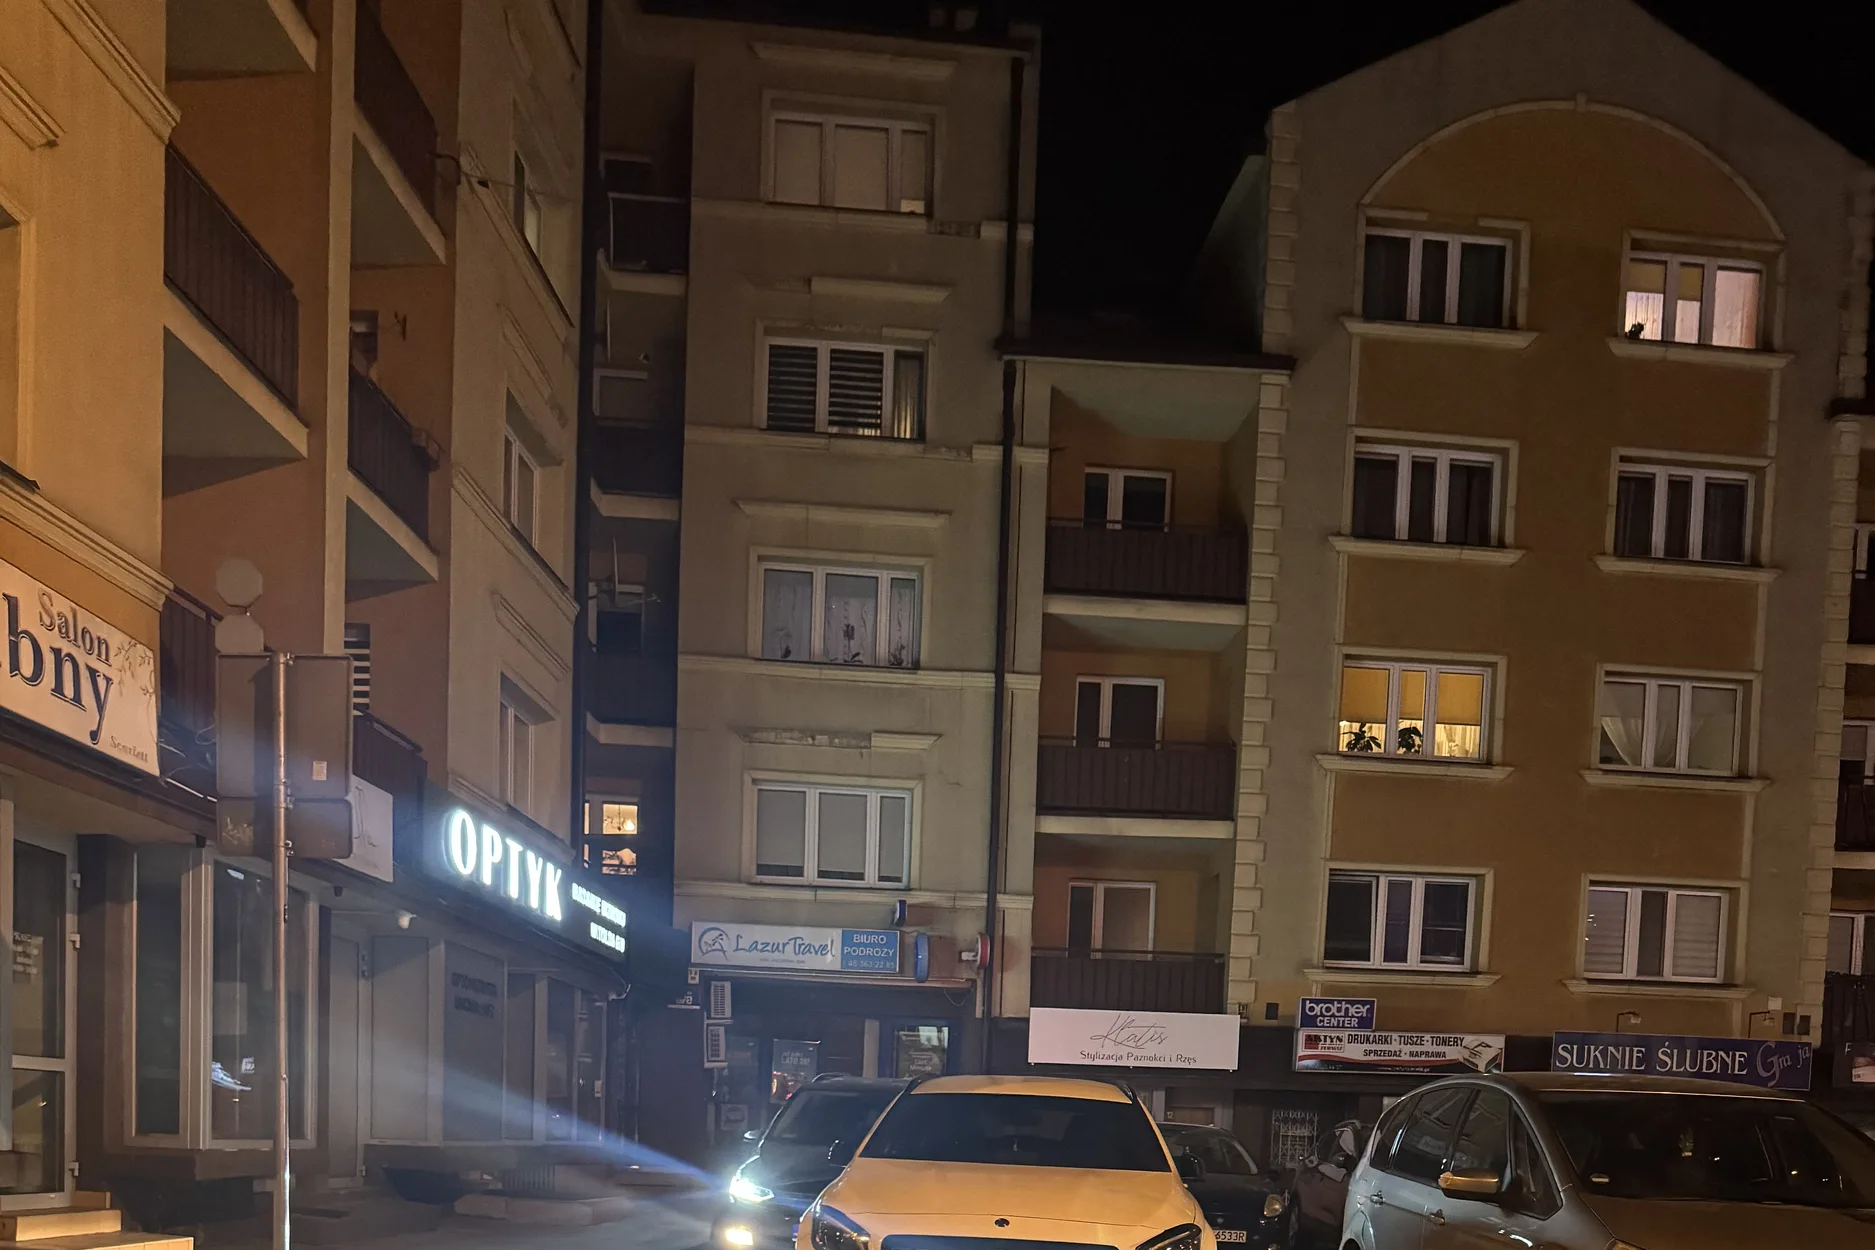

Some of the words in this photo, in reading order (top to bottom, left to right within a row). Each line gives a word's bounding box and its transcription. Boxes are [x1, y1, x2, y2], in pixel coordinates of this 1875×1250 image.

[38, 587, 112, 667] Salon
[0, 591, 114, 745] bny
[450, 809, 563, 922] OPTYK
[853, 934, 887, 944] BIURO
[1305, 1000, 1370, 1018] brother
[1316, 1016, 1359, 1027] CENTER
[1347, 1033, 1393, 1045] DRUKARKI
[1398, 1034, 1425, 1046] TUSZE
[1430, 1035, 1466, 1048] TONERY
[1079, 1050, 1123, 1063] Stylizacja
[1126, 1051, 1166, 1063] Paznokci
[1176, 1053, 1197, 1065] Rzęs
[1363, 1048, 1403, 1058] SPRZEDAŻ
[1409, 1050, 1447, 1059] NAPRAWA
[1555, 1043, 1646, 1071] SUKNIE
[1656, 1041, 1748, 1075] ŚLUBNE
